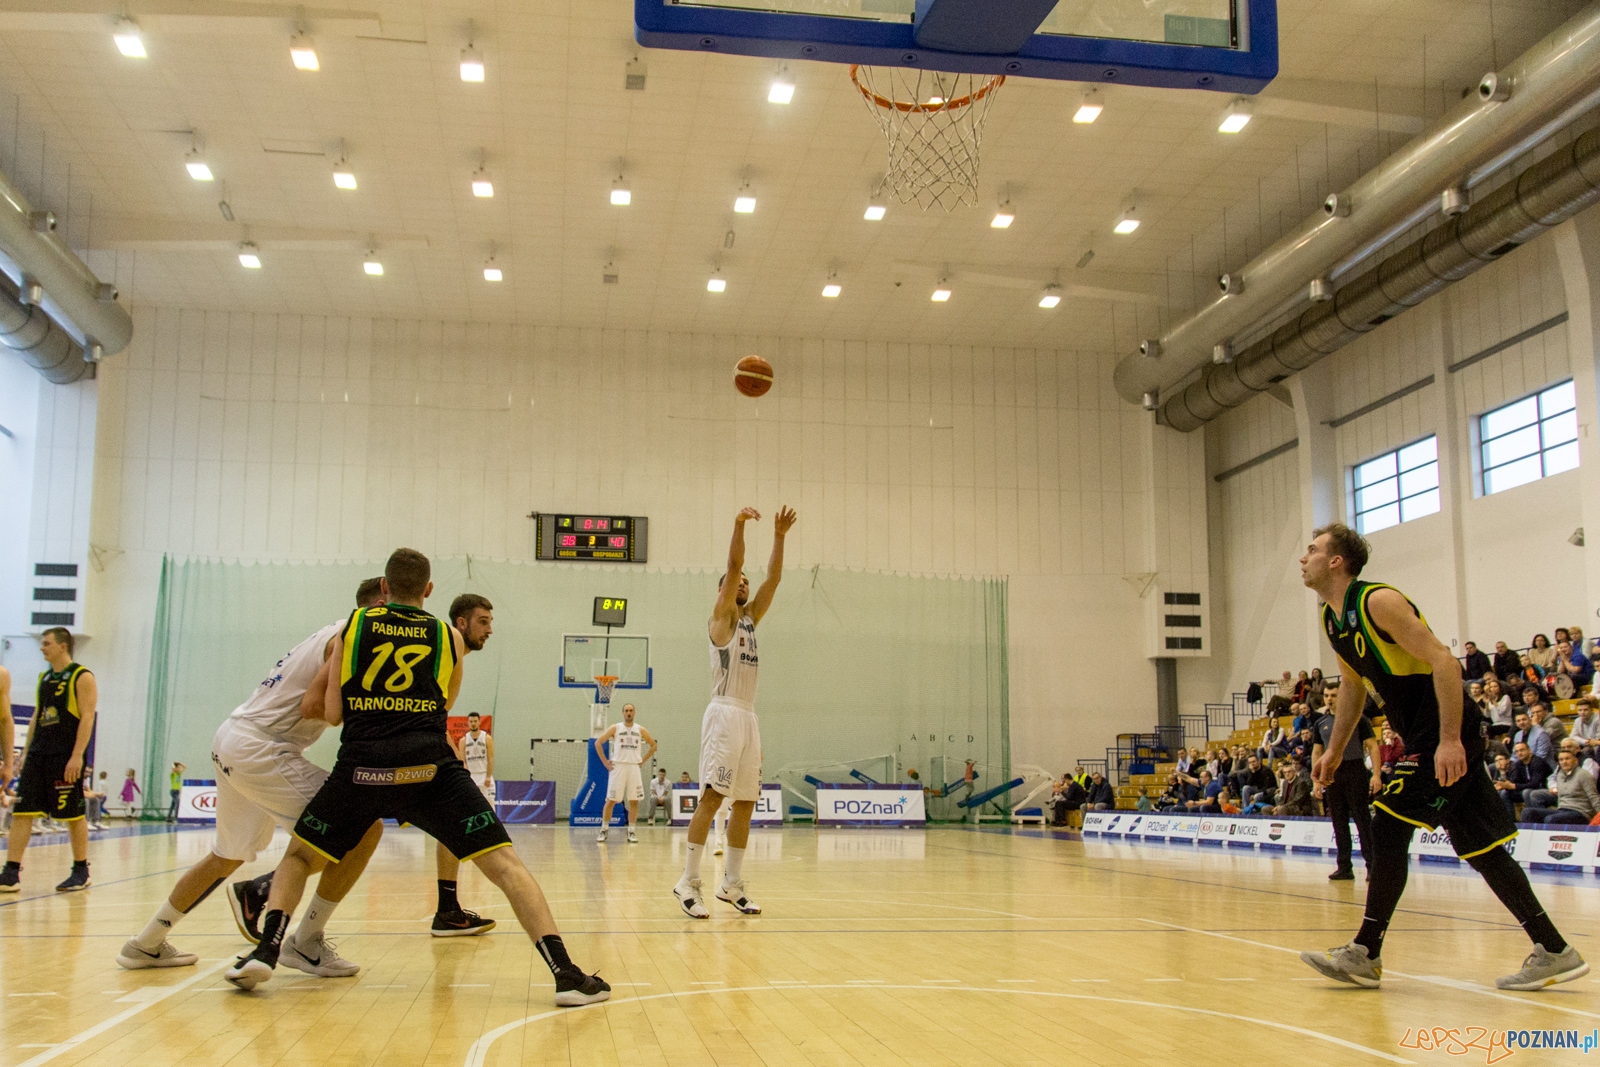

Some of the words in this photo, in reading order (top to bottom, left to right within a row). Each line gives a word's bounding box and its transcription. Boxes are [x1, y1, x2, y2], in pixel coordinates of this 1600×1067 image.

[563, 518, 570, 527] 2
[588, 535, 596, 545] 3
[610, 536, 624, 547] 40
[372, 621, 427, 639] PABIANEK
[1354, 631, 1366, 658] 0
[361, 641, 432, 692] 18
[54, 681, 67, 696] 5
[347, 696, 437, 713] TARNOBRZEG
[356, 771, 394, 782] TRANS
[717, 766, 733, 785] 14
[57, 794, 69, 810] 5
[200, 797, 217, 808] KI
[1236, 826, 1258, 836] NICKEL
[1420, 832, 1452, 845] BIOFA
[1551, 842, 1572, 851] JOKER
